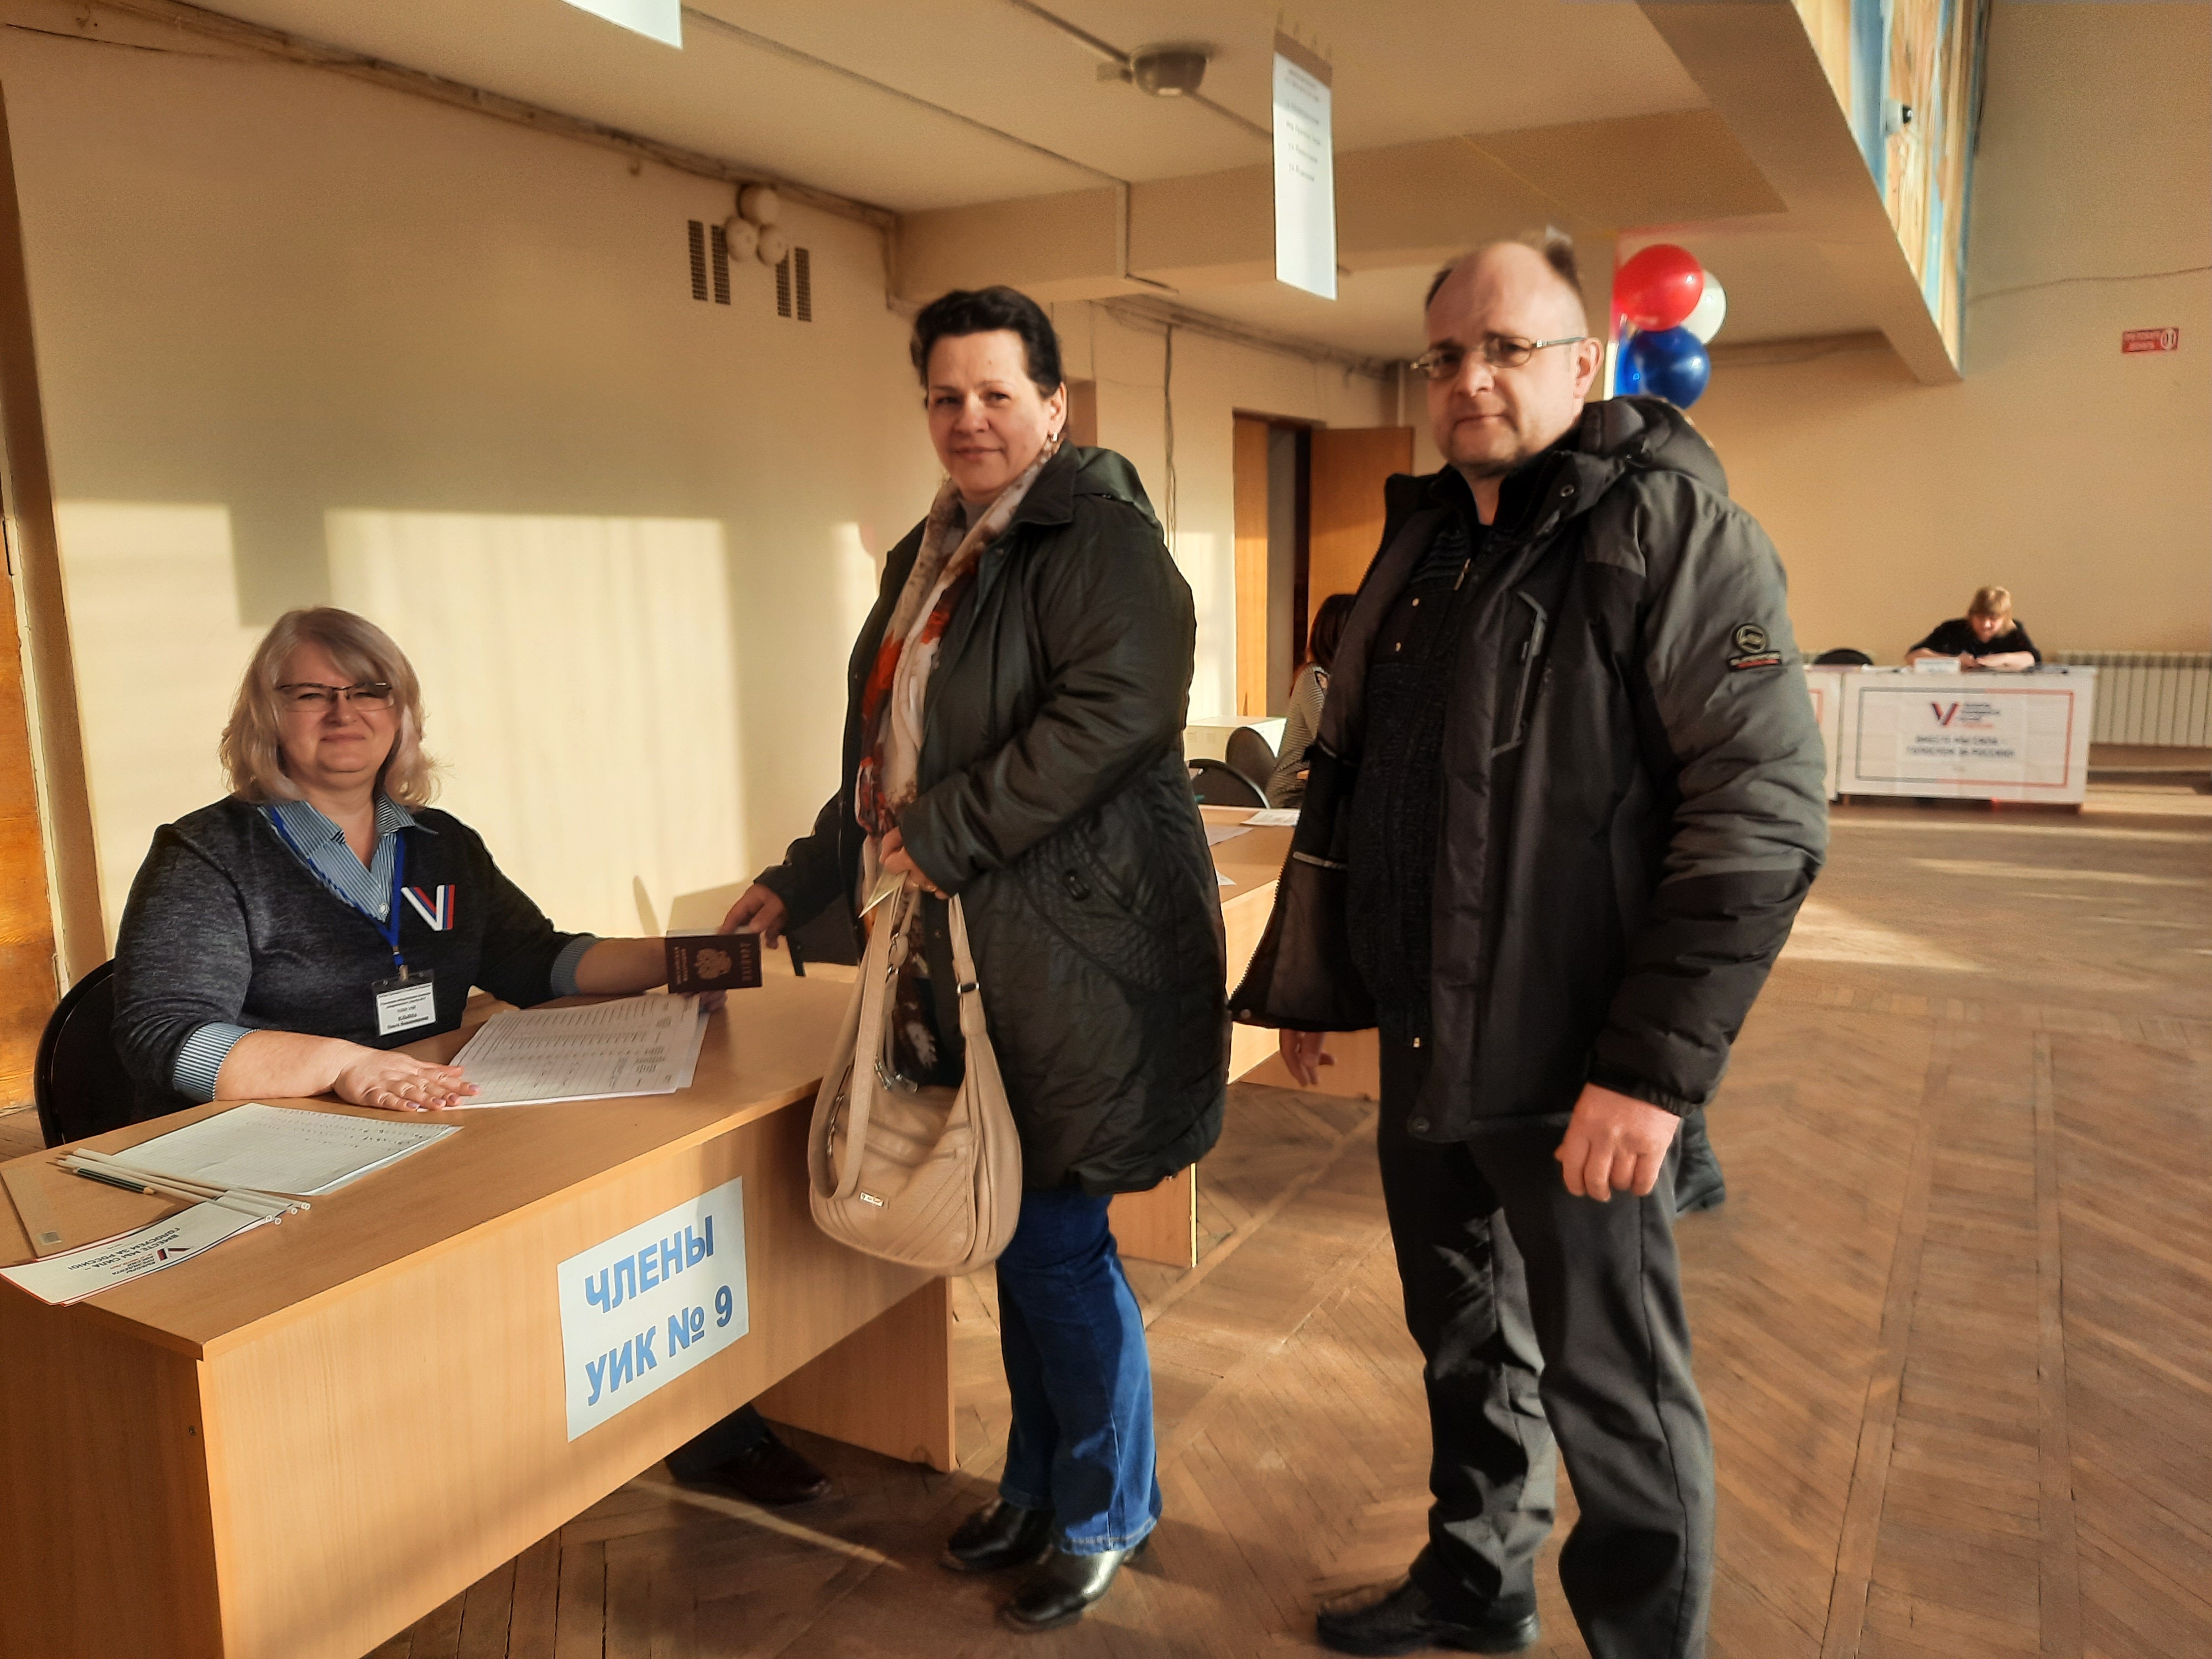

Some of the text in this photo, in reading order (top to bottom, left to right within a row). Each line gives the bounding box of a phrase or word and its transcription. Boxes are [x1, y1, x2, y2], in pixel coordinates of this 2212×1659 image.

[129, 1227, 181, 1250] ГОЛОСУЕМ
[140, 1234, 180, 1251] ВМЕСТЕ
[91, 1257, 121, 1267] СИЛА
[585, 1214, 714, 1313] ЧЛЕНЫ
[585, 1285, 733, 1406] УИК № 9
